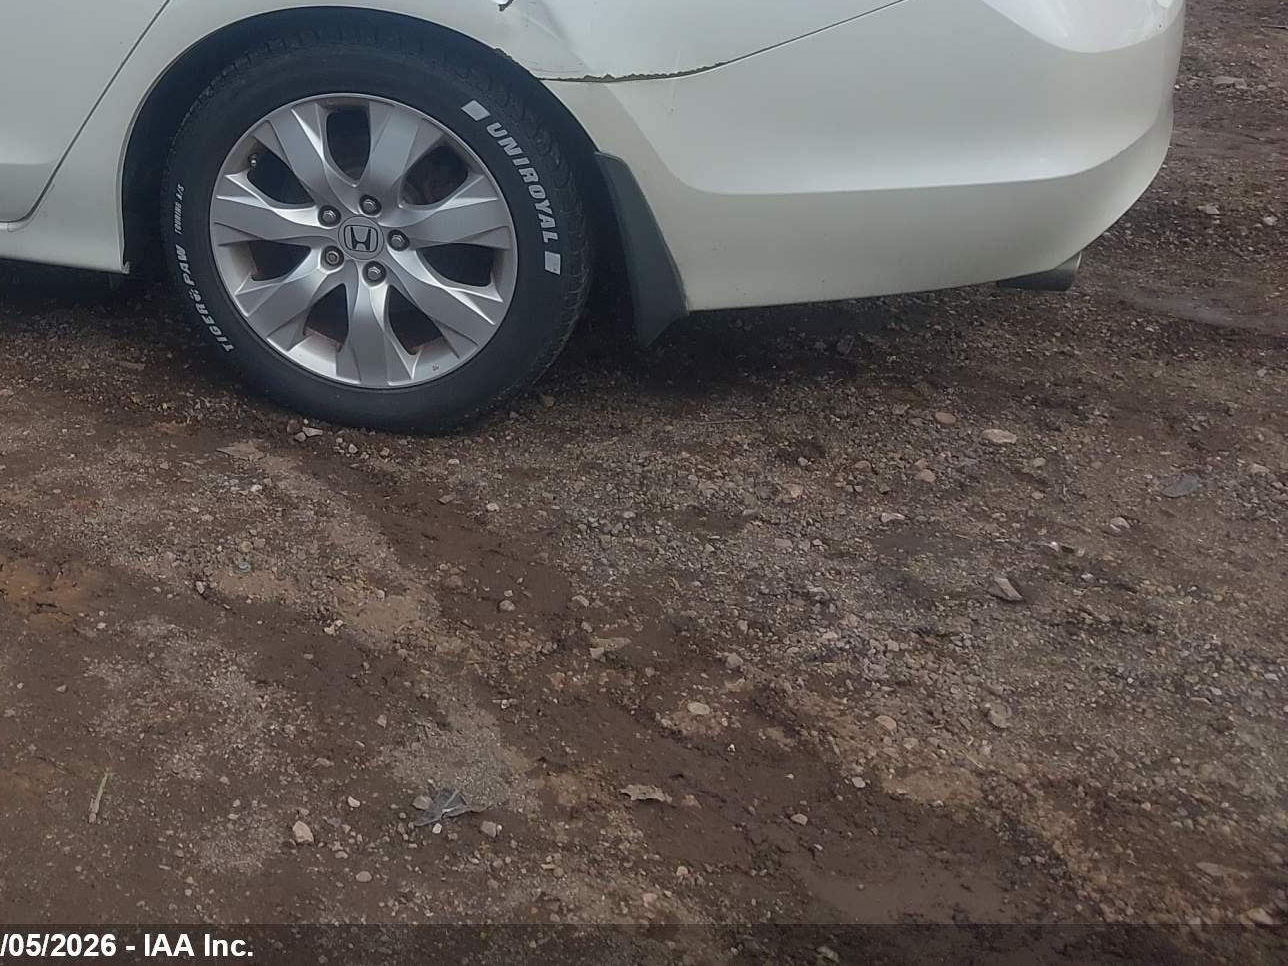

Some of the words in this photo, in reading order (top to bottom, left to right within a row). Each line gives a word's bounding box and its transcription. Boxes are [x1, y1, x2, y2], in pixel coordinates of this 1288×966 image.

[486, 121, 559, 243] UNIROYAL
[175, 244, 195, 286] PAW
[195, 302, 235, 352] TIGER
